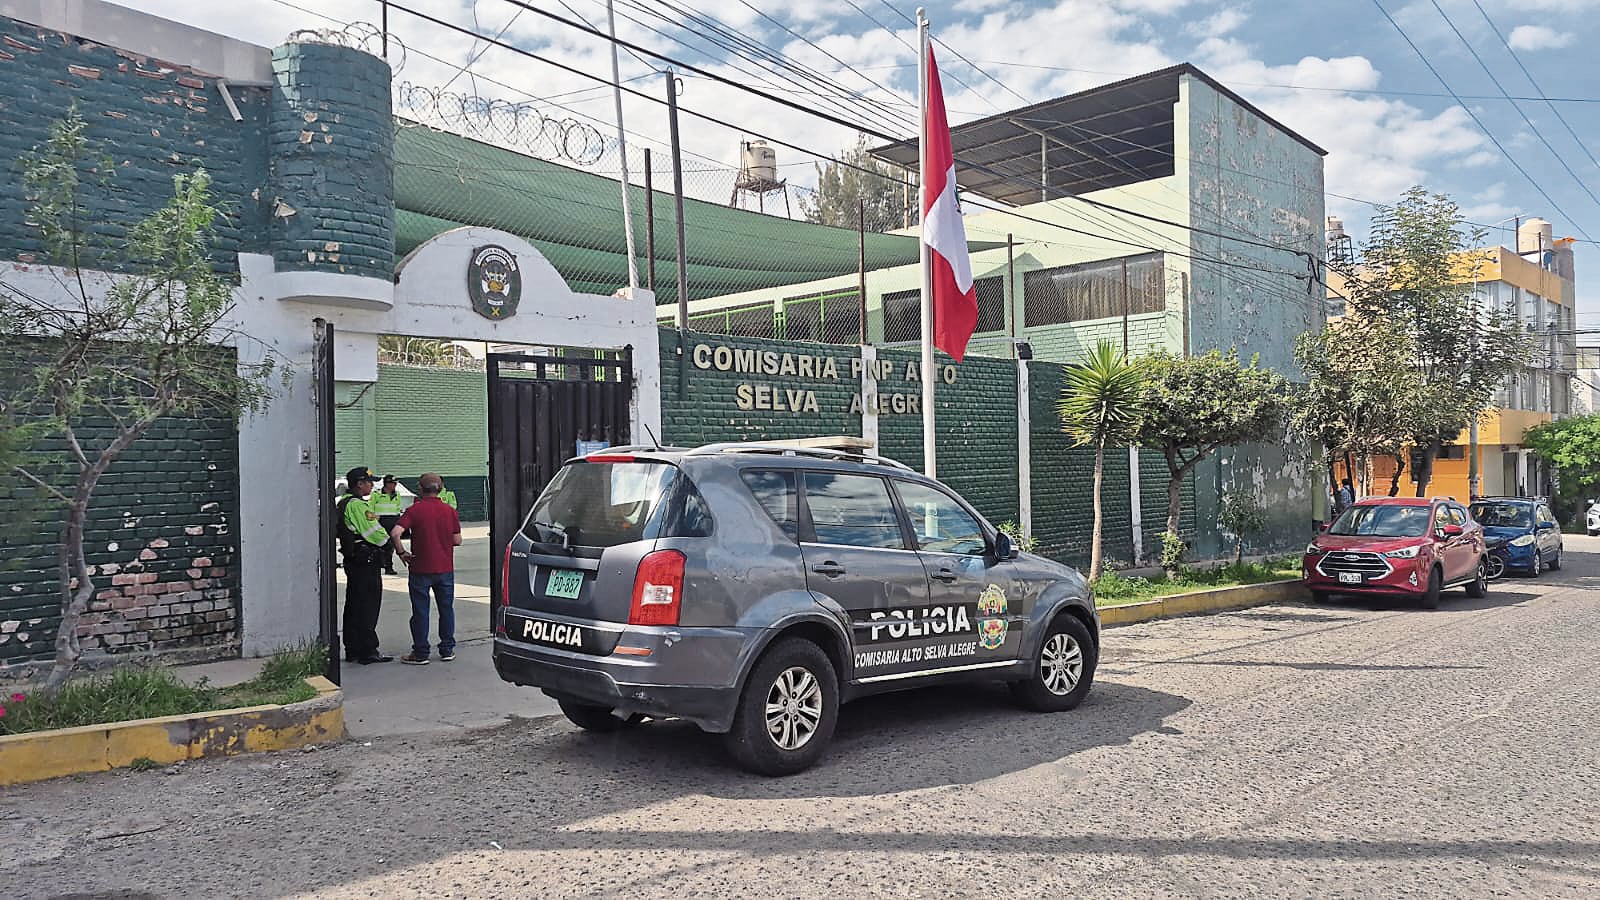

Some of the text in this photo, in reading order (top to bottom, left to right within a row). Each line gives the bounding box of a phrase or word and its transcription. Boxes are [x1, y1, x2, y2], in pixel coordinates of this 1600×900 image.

[693, 344, 956, 385] COMISARIA PNP ATO
[736, 384, 922, 415] SELVA ALEGR
[523, 619, 582, 647] POLICIA
[871, 606, 971, 640] POLICIA
[854, 641, 976, 668] COMISARIA ALTO SELVA ALEGRE
